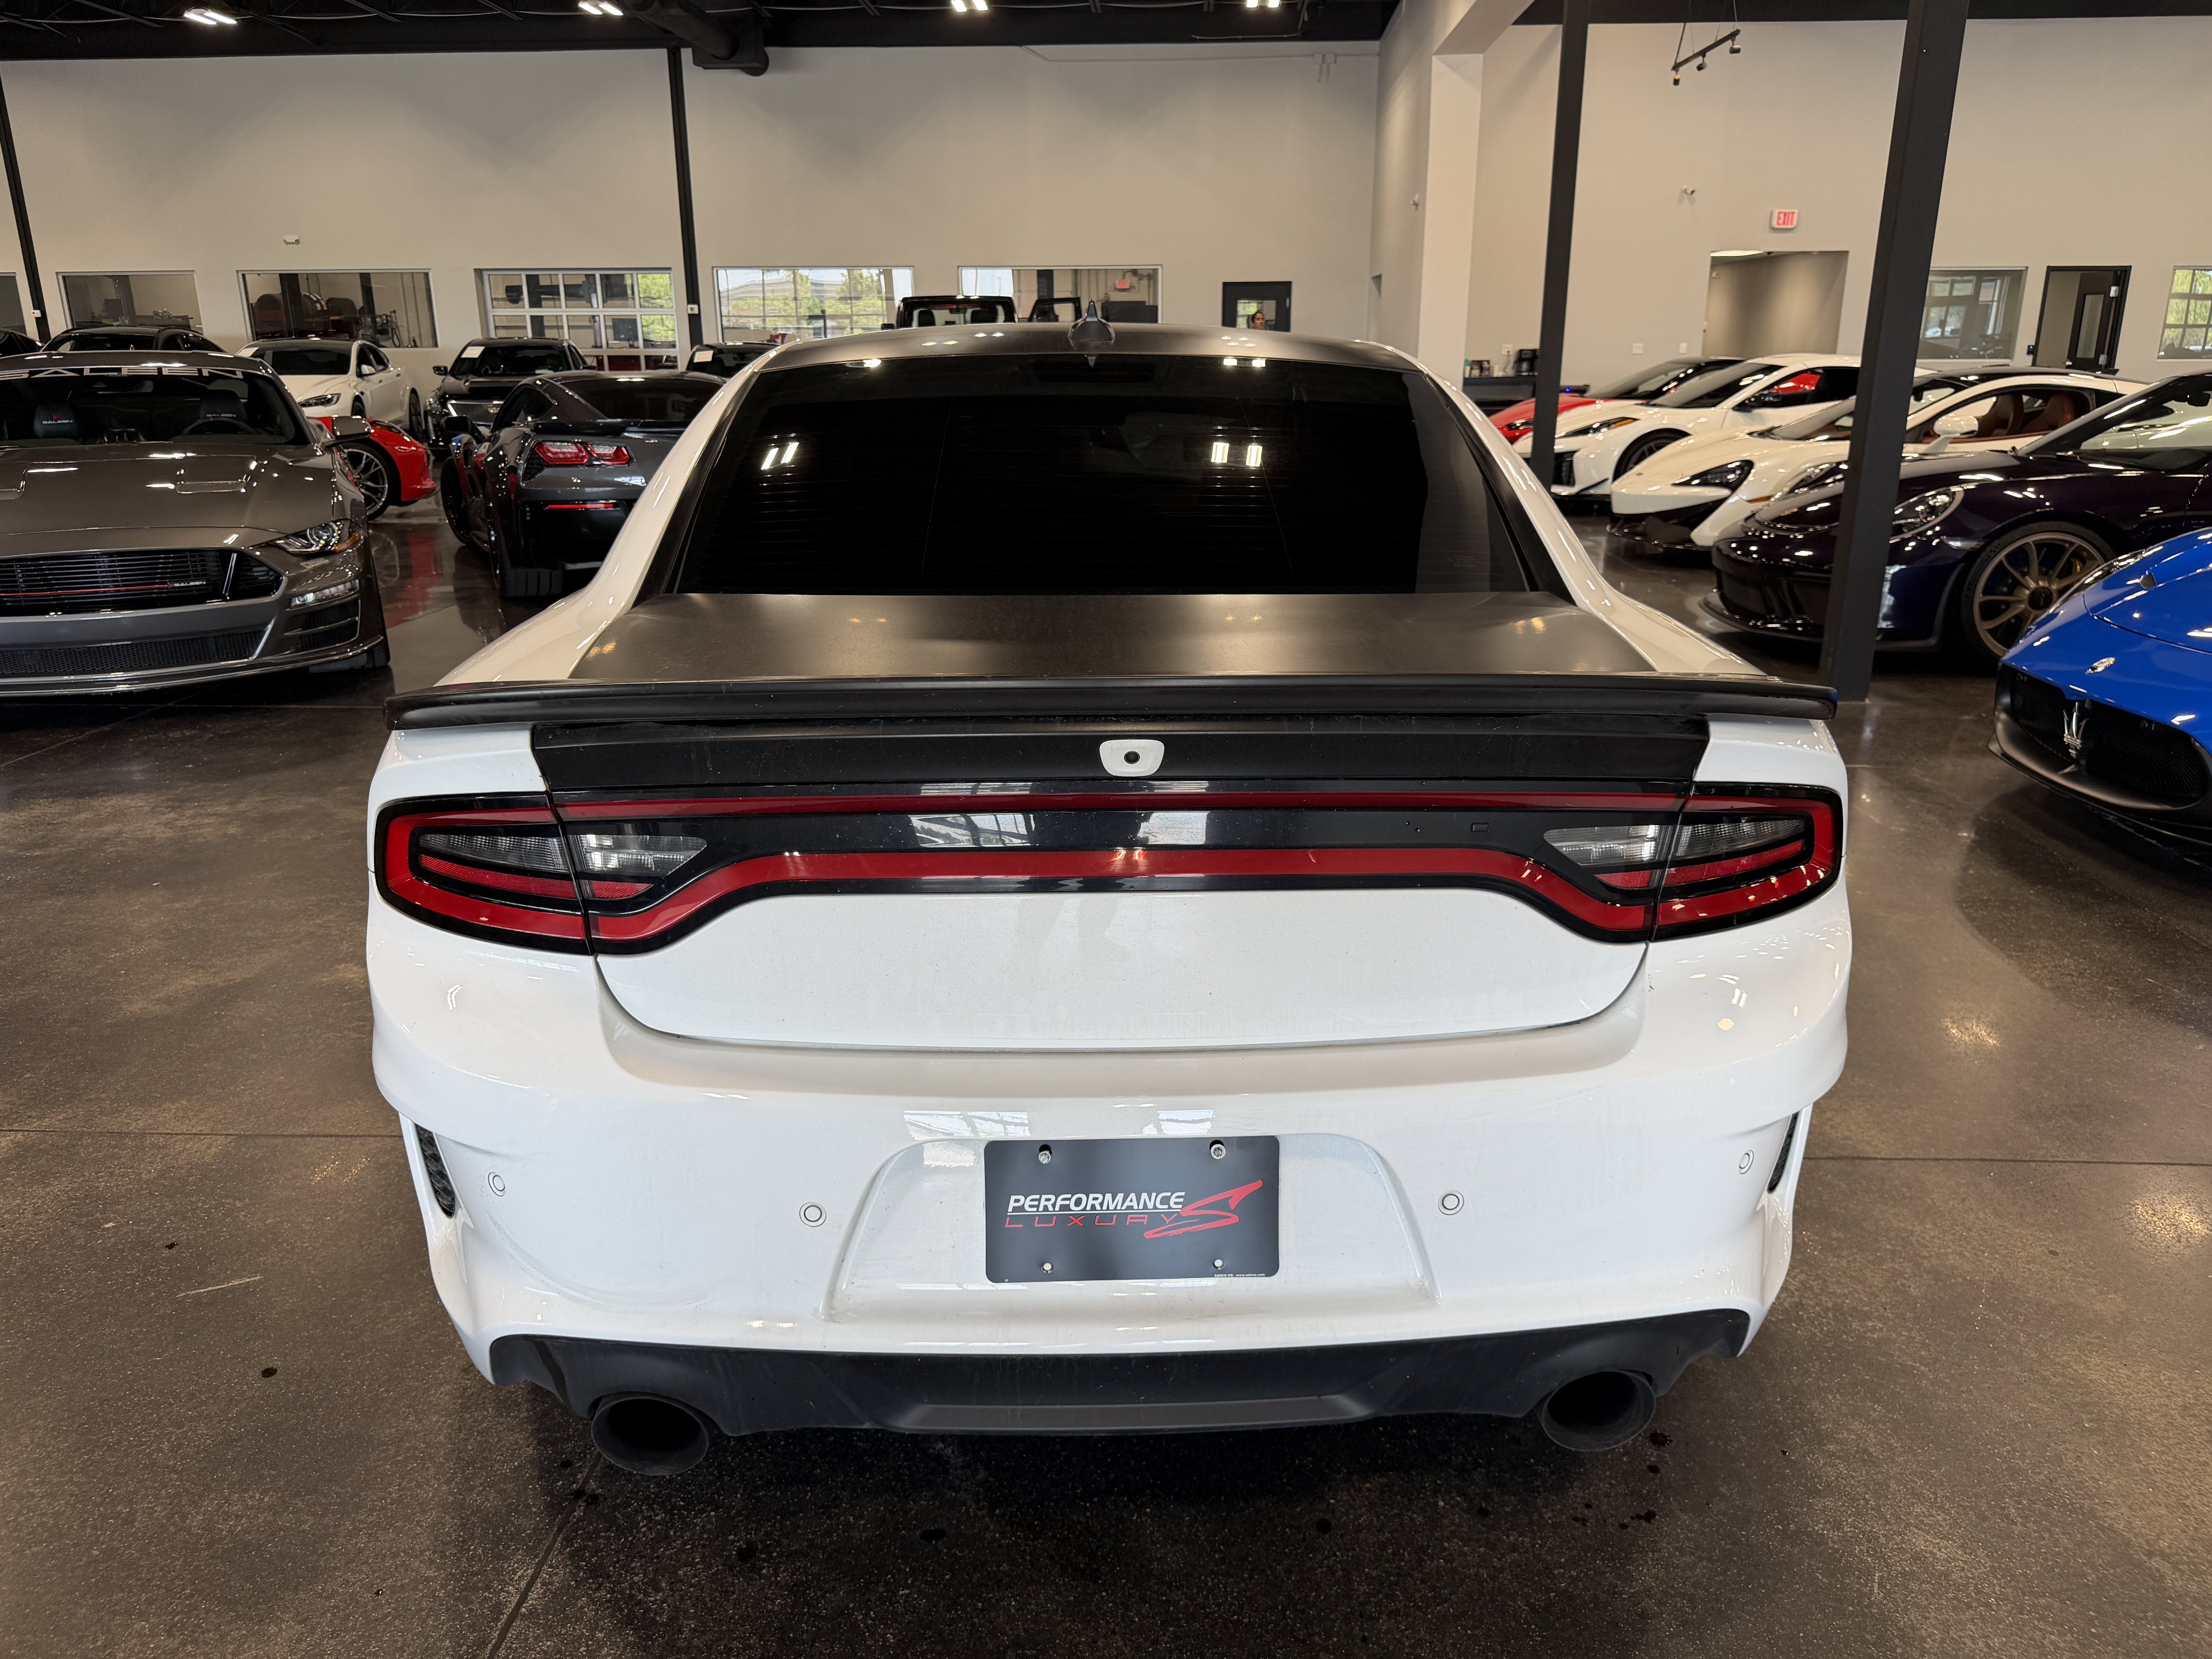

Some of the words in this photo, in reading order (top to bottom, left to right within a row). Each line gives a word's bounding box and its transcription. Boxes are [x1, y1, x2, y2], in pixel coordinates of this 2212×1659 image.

[1777, 211, 1796, 226] EXIT
[0, 368, 244, 380] SALEEN
[1008, 1192, 1185, 1212] PERFORMANCE
[1005, 1214, 1177, 1227] LUXURY
